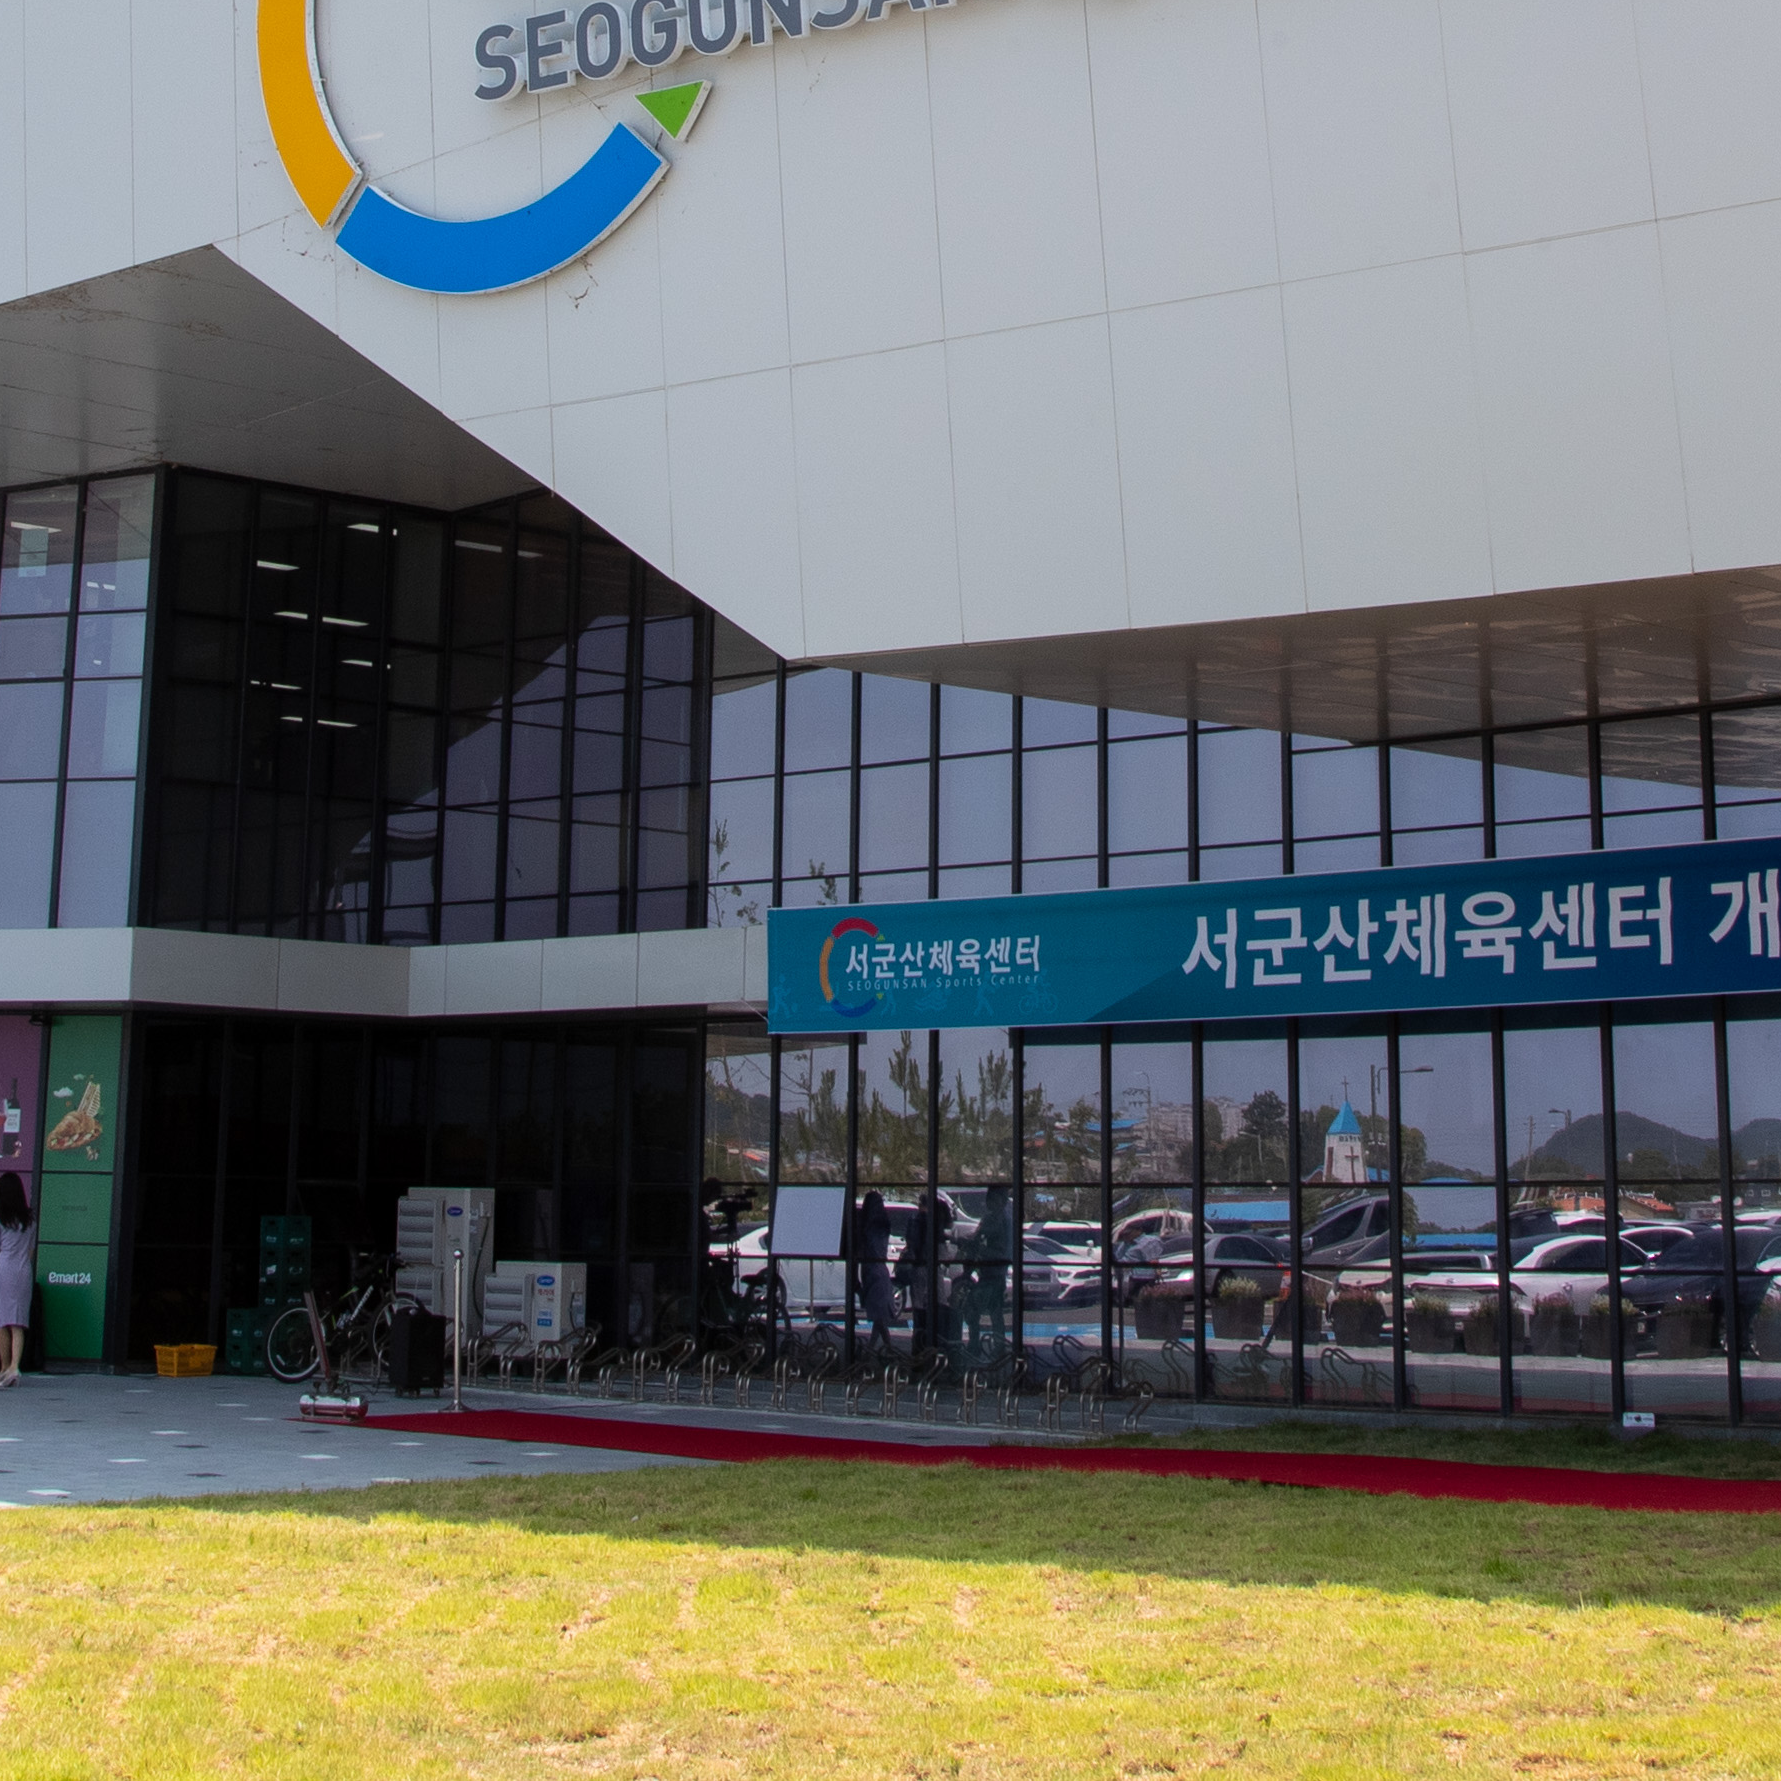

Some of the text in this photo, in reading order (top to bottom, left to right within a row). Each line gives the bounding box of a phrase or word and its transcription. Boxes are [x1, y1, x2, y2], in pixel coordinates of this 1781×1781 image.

[1182, 877, 1673, 989] 서군산체육센터
[845, 934, 1040, 980] 서군산체육센터
[847, 974, 1039, 991] SEOGUNSAN Sports Center
[48, 1271, 92, 1285] emart24
